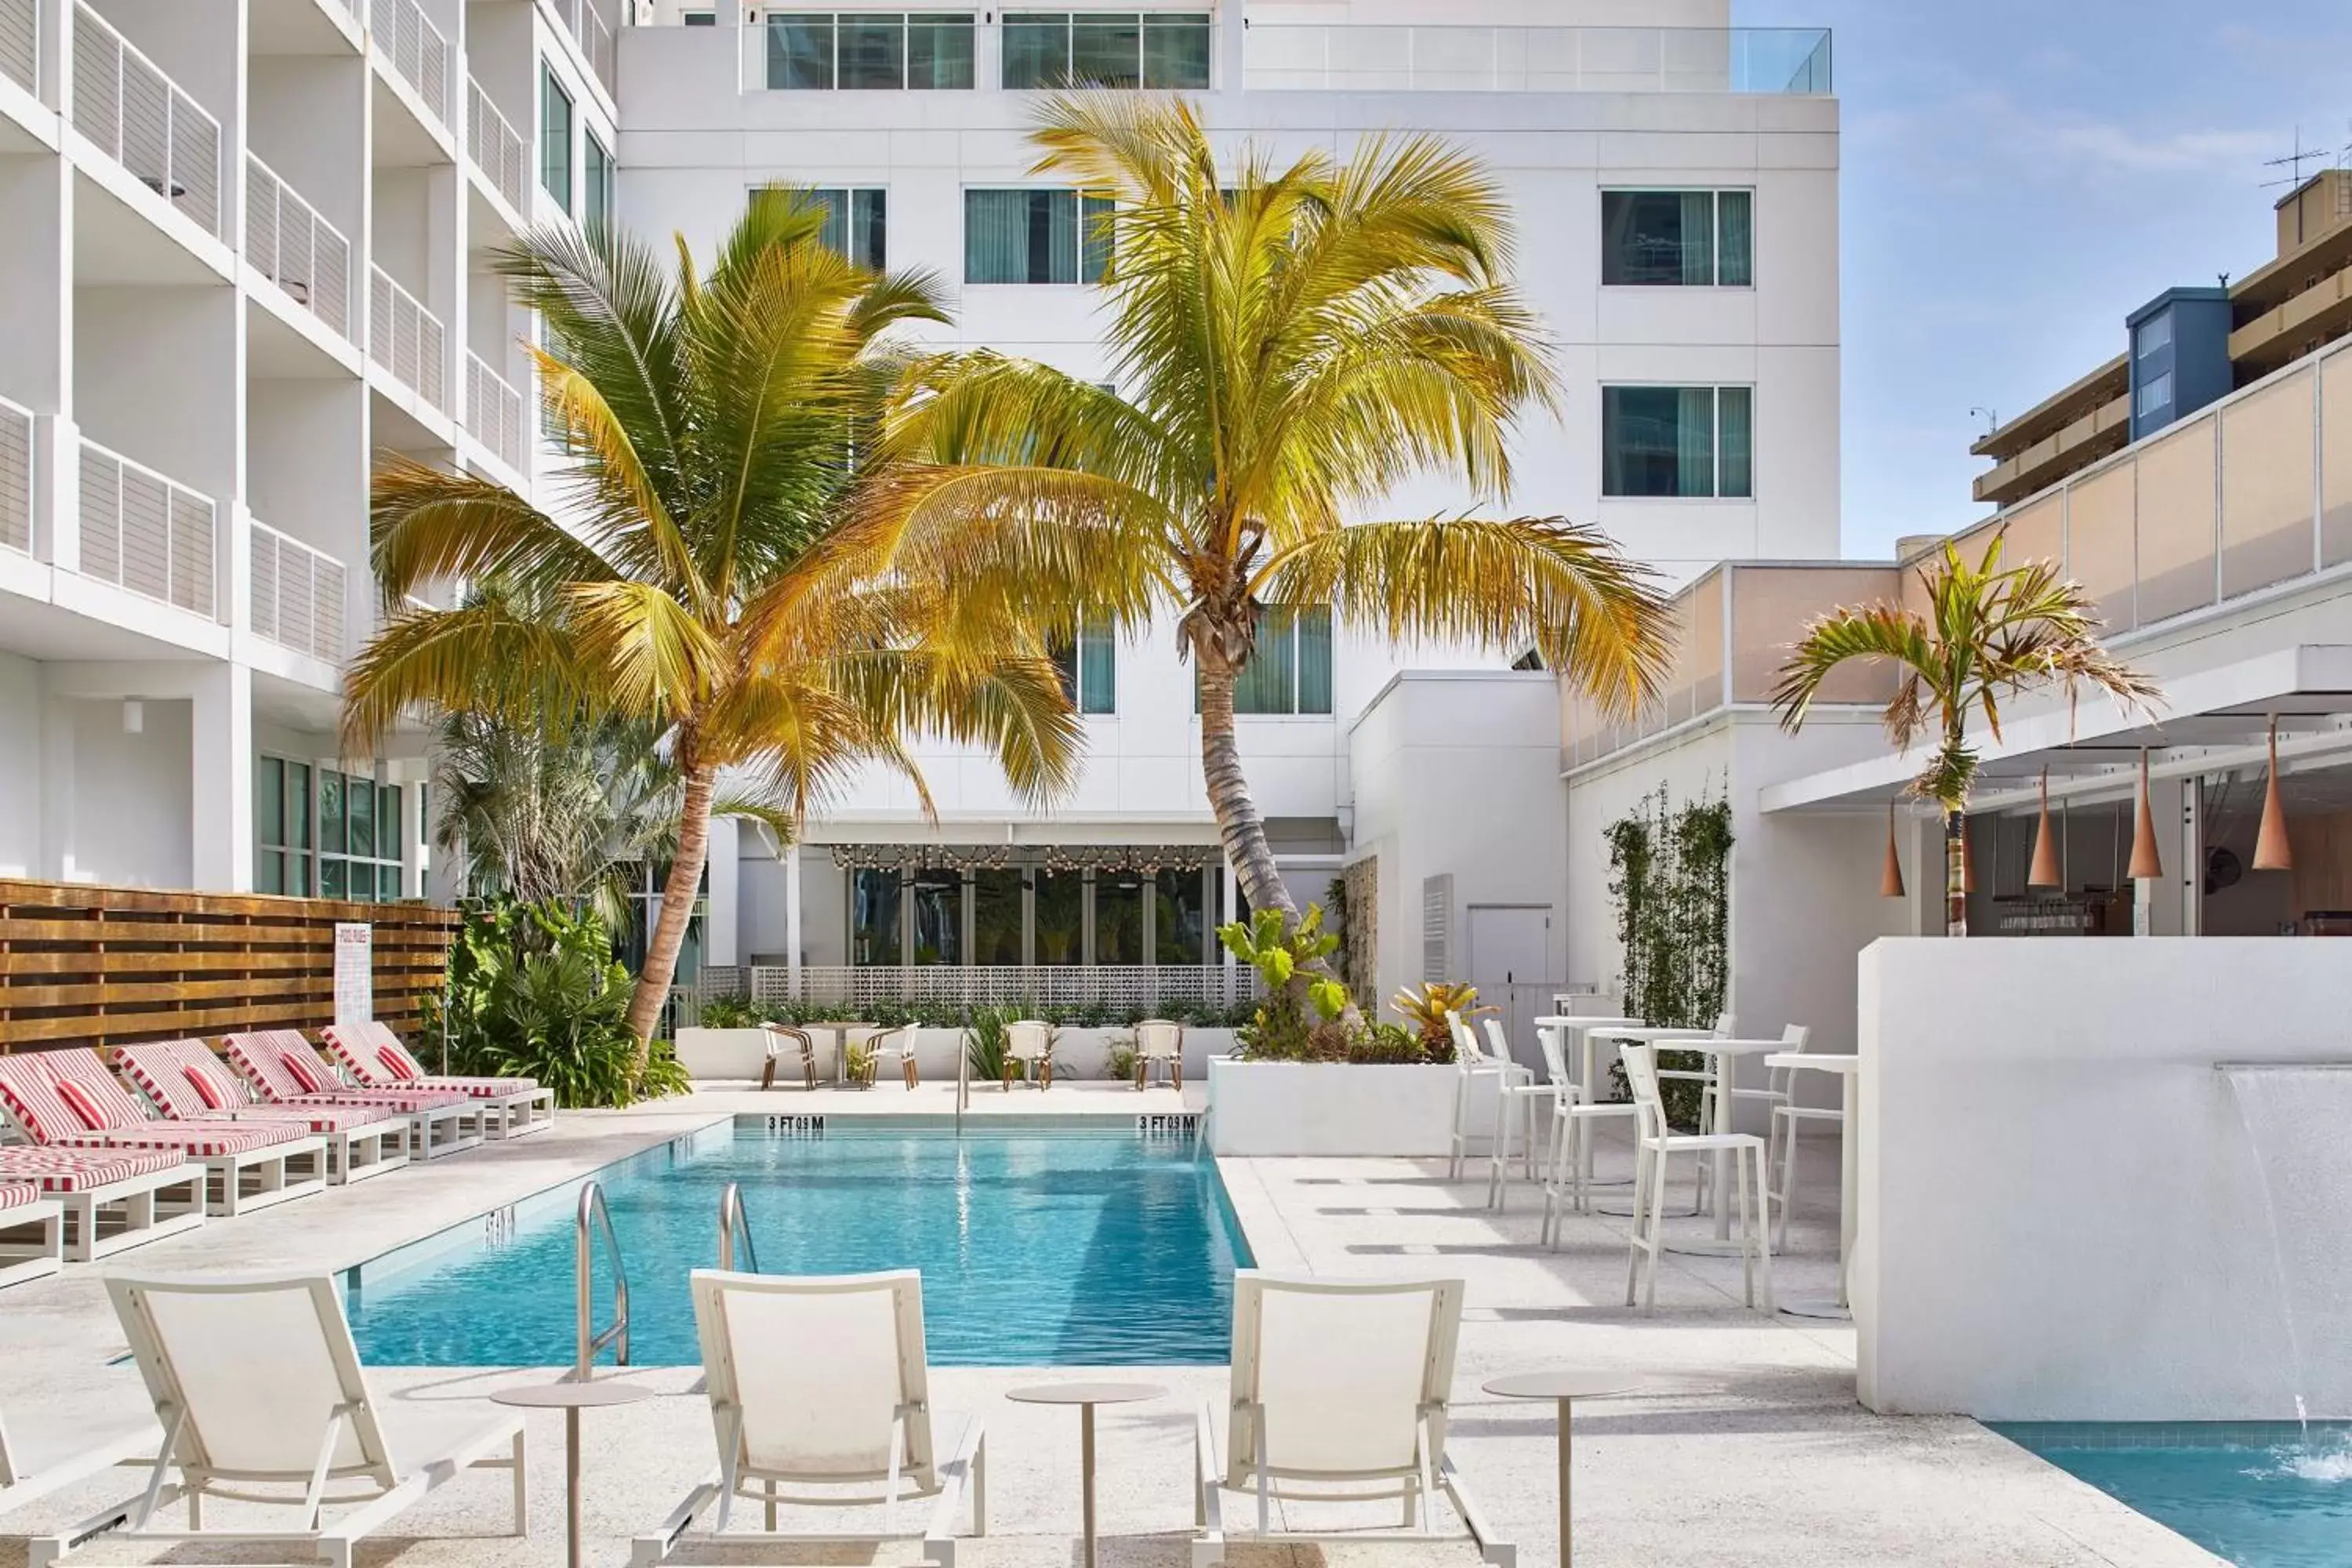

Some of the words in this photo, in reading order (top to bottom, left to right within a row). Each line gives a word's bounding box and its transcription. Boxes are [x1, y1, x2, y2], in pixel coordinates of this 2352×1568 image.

[340, 929, 352, 944] POOL
[768, 1116, 775, 1130] 3
[780, 1116, 793, 1130] FT
[811, 1116, 824, 1130] M
[1140, 1116, 1147, 1130] 3
[1152, 1116, 1165, 1130] FT
[1183, 1116, 1196, 1130] M
